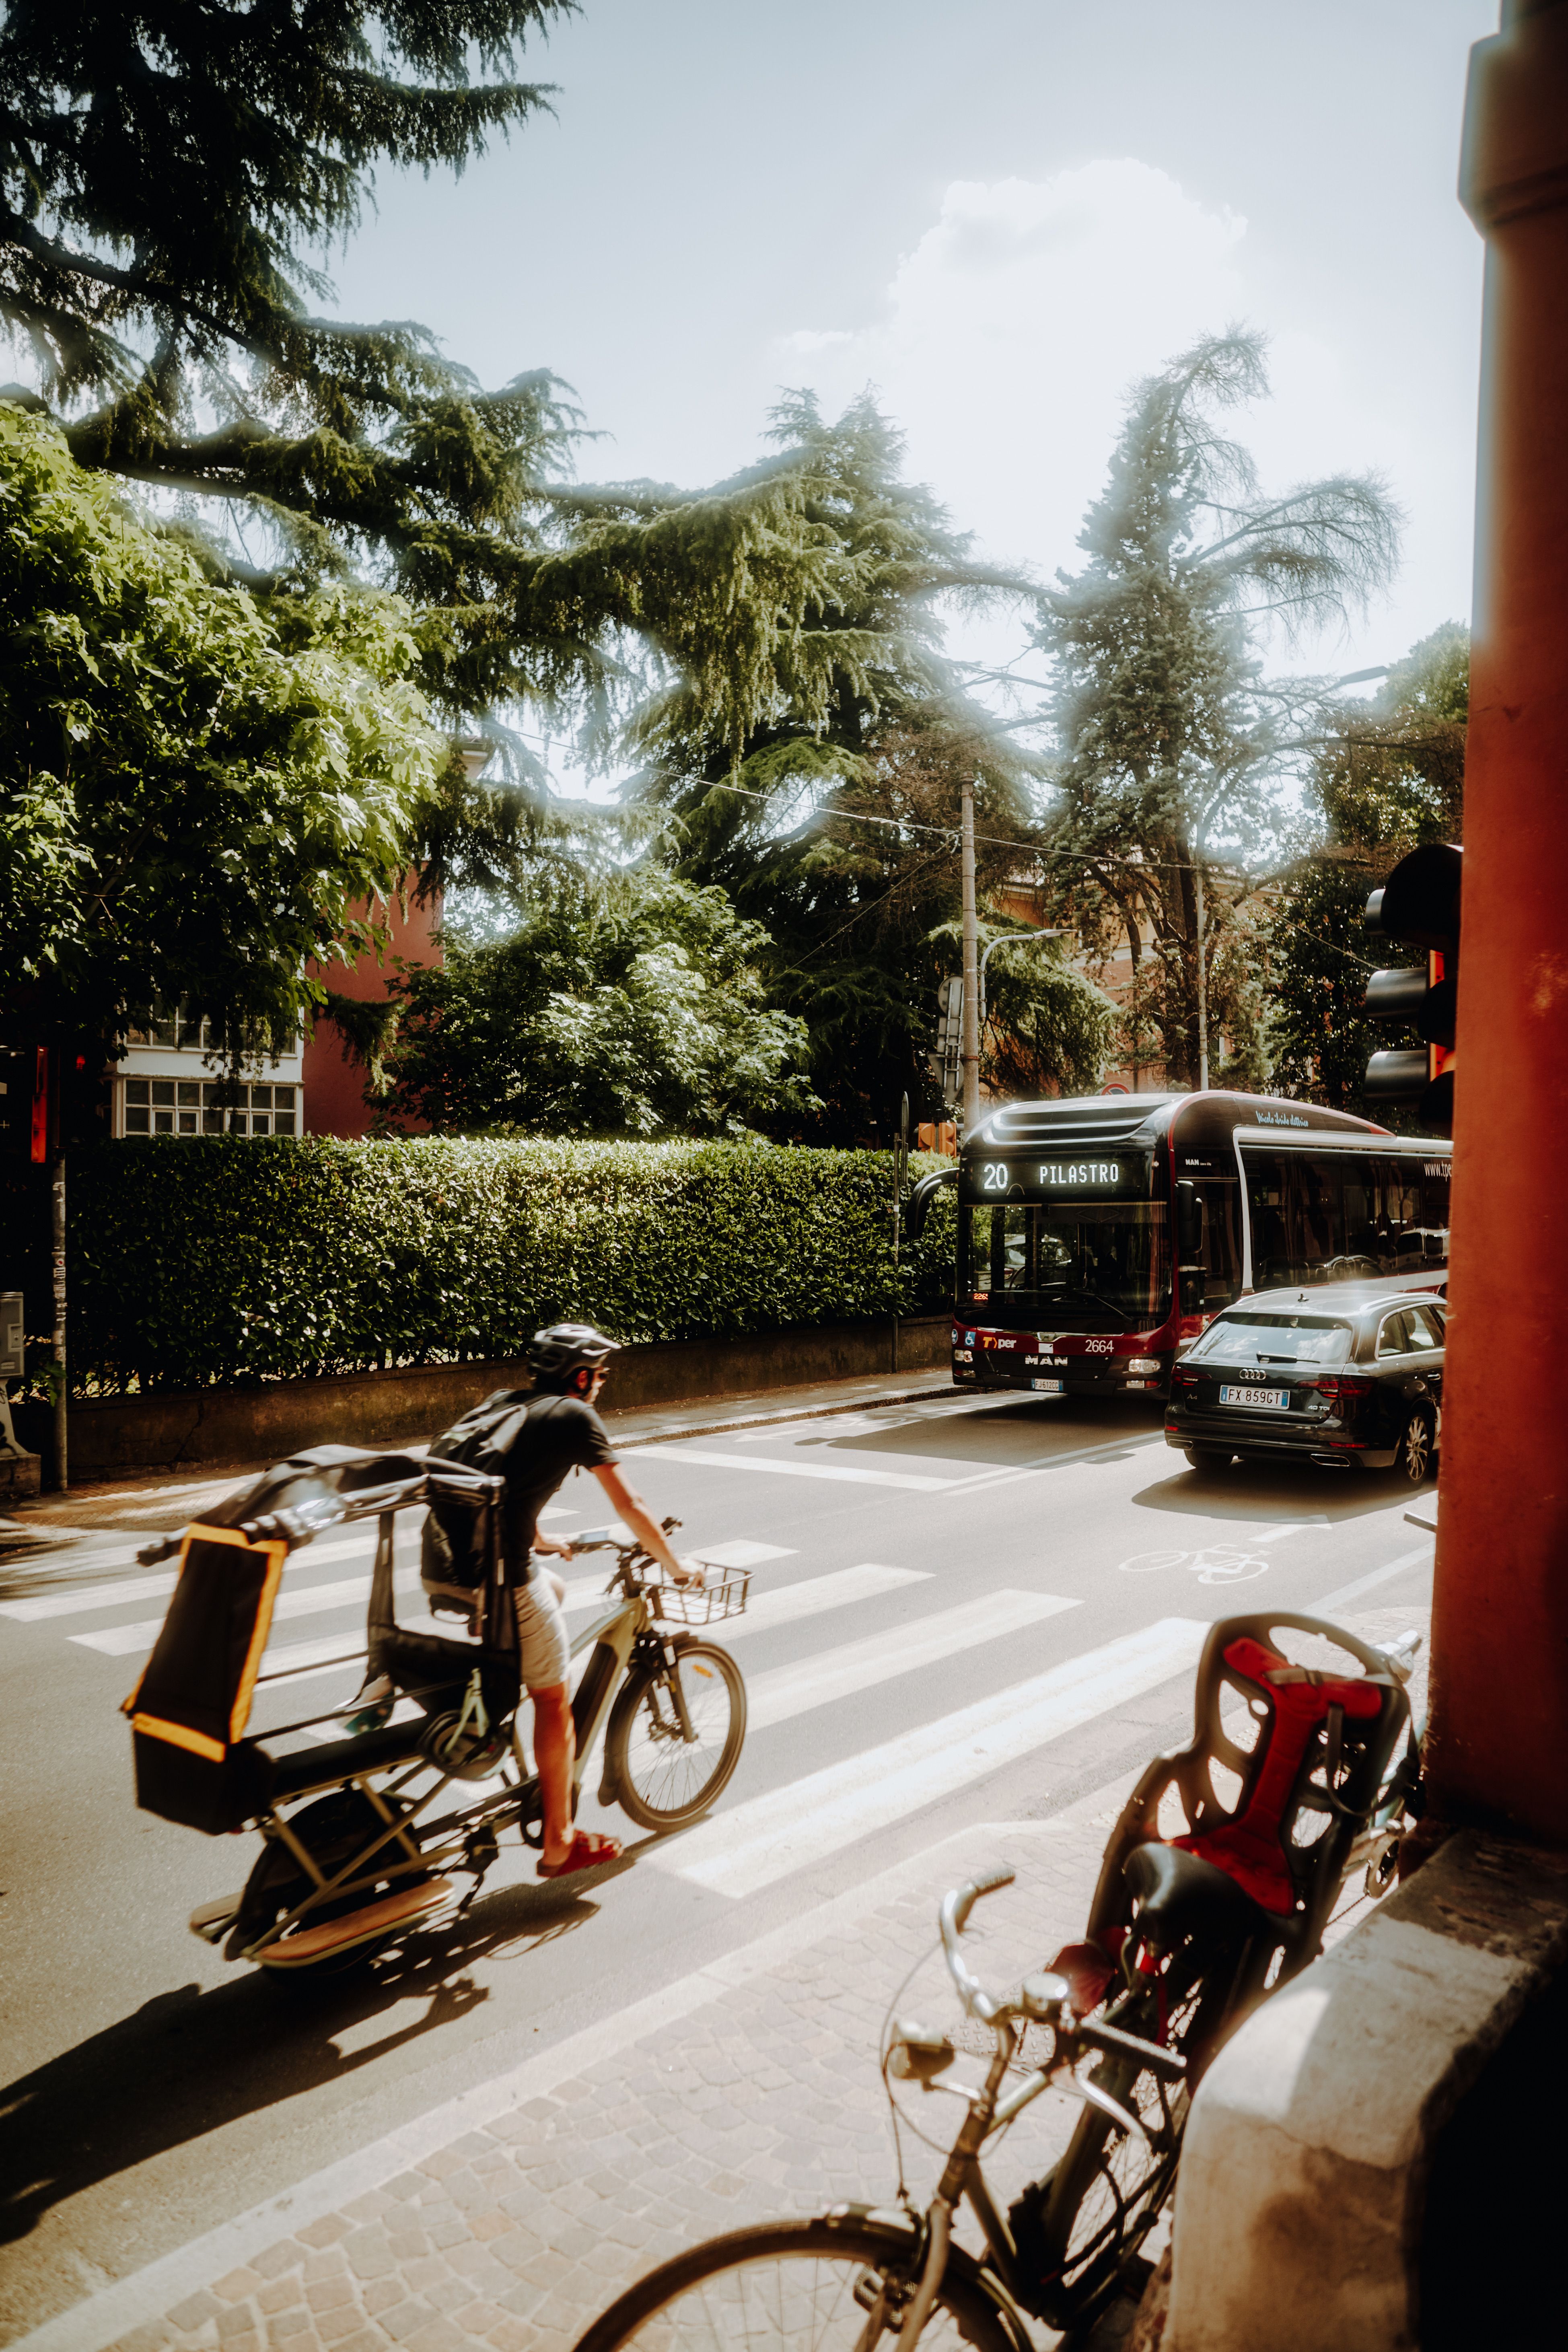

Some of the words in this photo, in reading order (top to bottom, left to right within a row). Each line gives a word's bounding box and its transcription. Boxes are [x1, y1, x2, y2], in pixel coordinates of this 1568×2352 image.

[1255, 1110, 1274, 1124] Veicolo
[984, 1163, 1008, 1189] 20
[1040, 1164, 1118, 1184] PILASTRO
[1424, 1160, 1453, 1182] www.tpe
[1085, 1339, 1114, 1353] 2664
[1025, 1355, 1068, 1366] MAN
